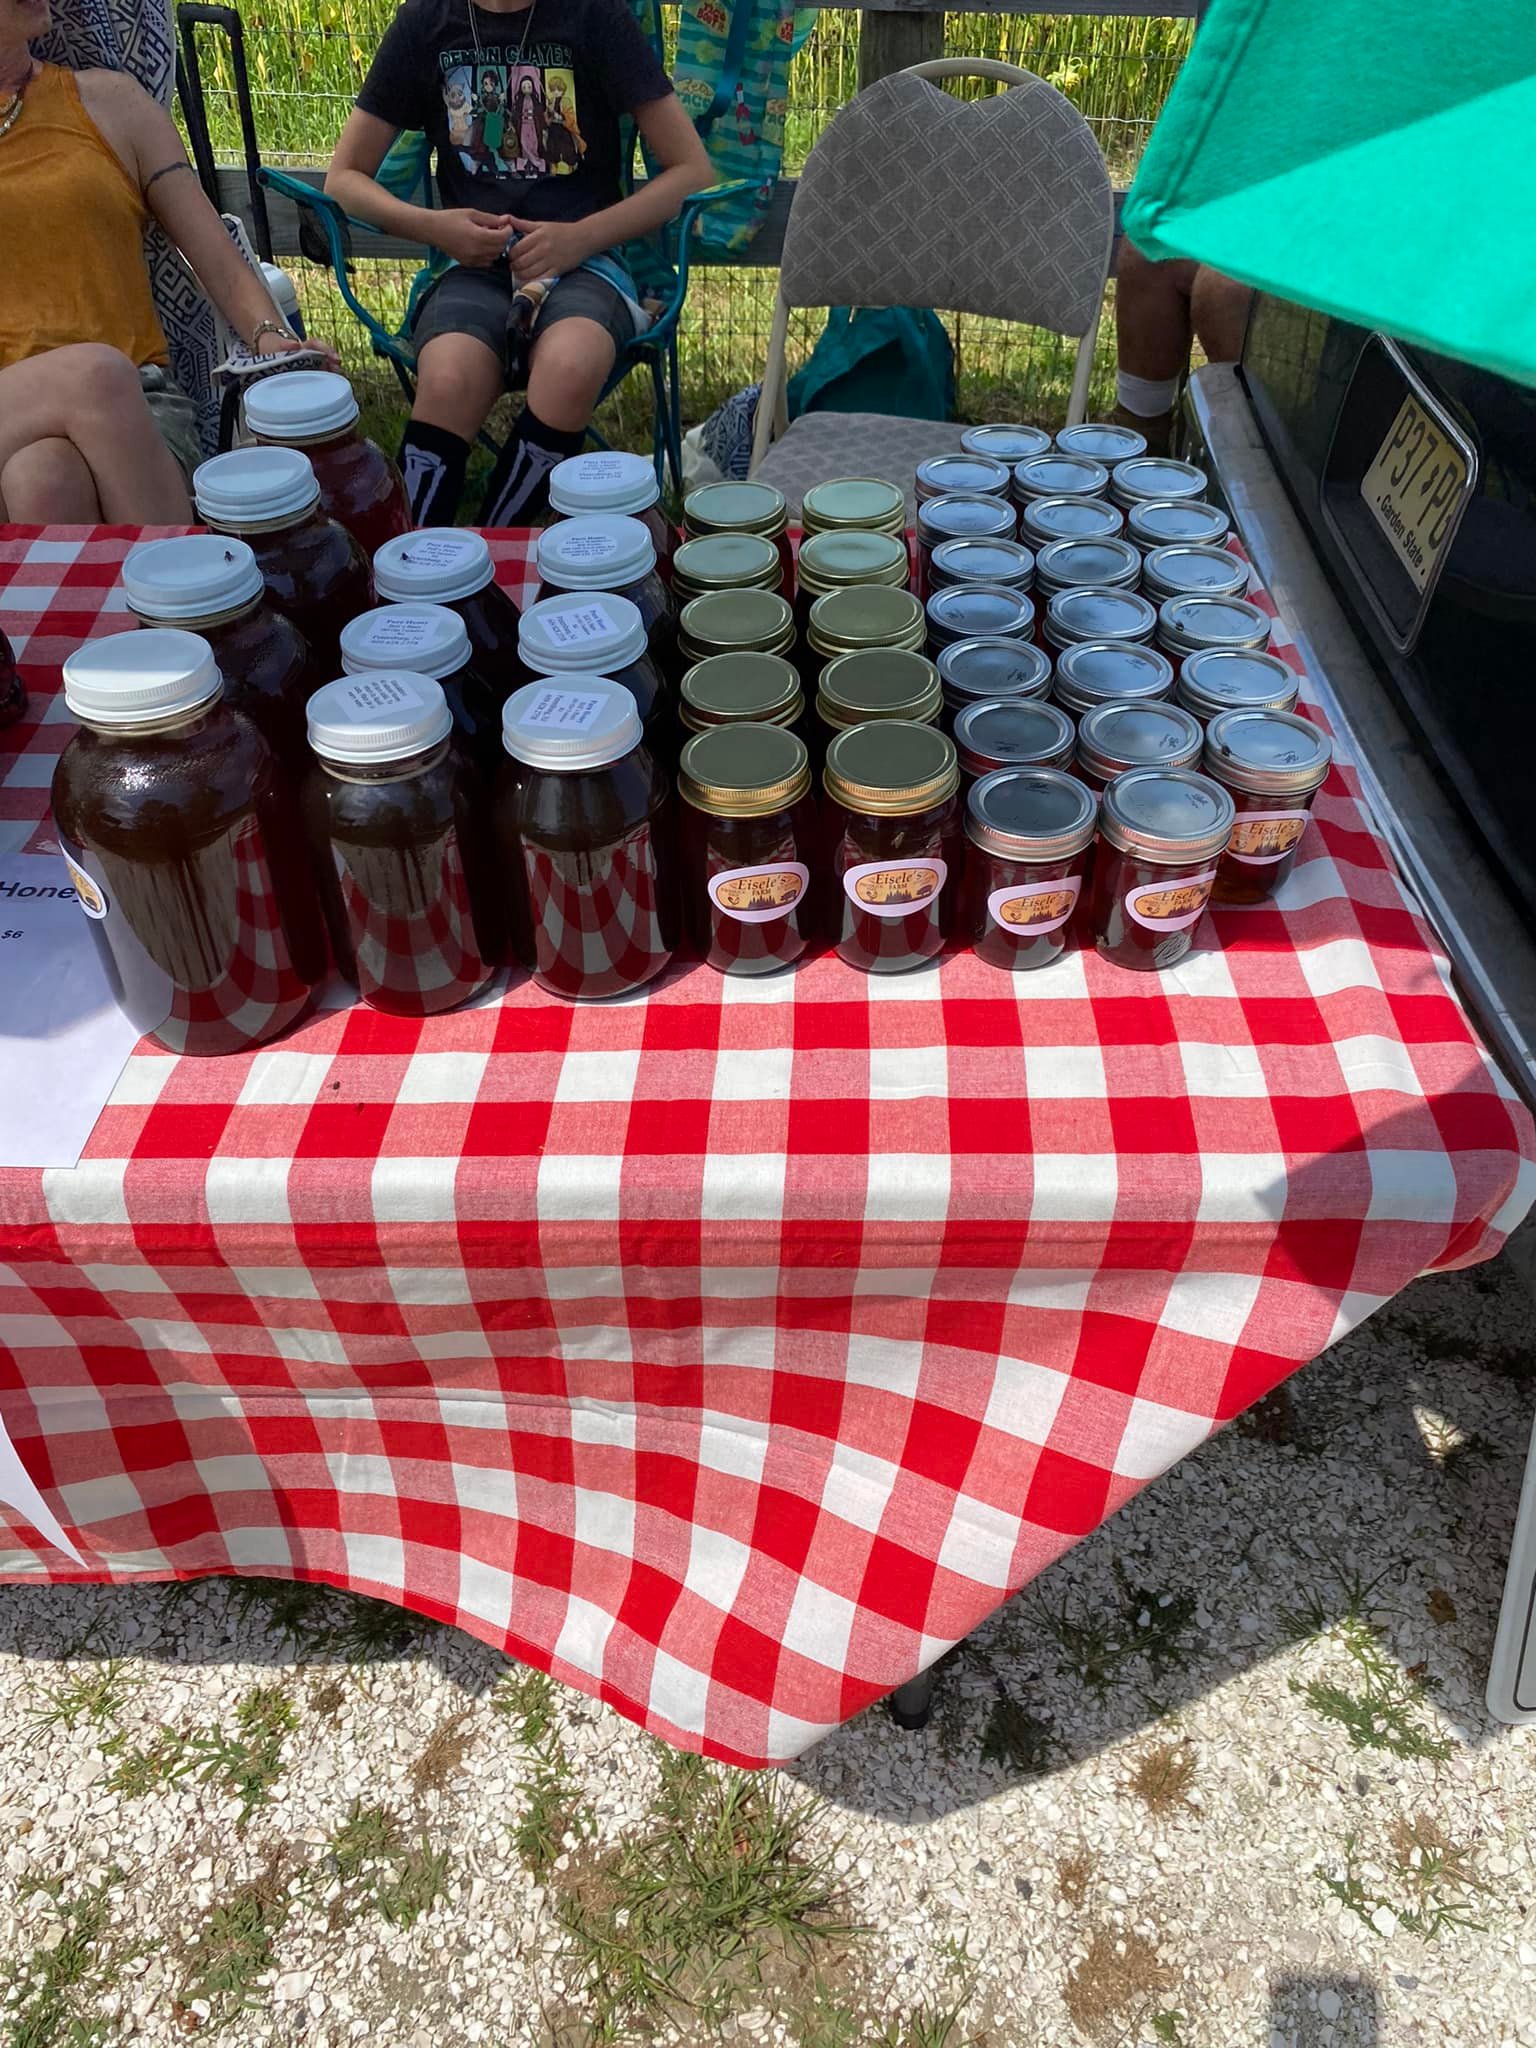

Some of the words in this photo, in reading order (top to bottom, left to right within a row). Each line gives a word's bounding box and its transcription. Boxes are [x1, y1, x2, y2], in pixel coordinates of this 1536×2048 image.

[439, 47, 501, 72] DEMON
[506, 43, 573, 67] SLAYER
[1379, 405, 1438, 498] P37
[1380, 494, 1406, 541] Garden
[1402, 530, 1425, 569] State
[1249, 821, 1299, 834] Eisele's
[738, 875, 786, 890] Eisele's
[876, 871, 922, 884] Eisele's
[0, 881, 80, 903] Hone
[1, 930, 24, 940] $6
